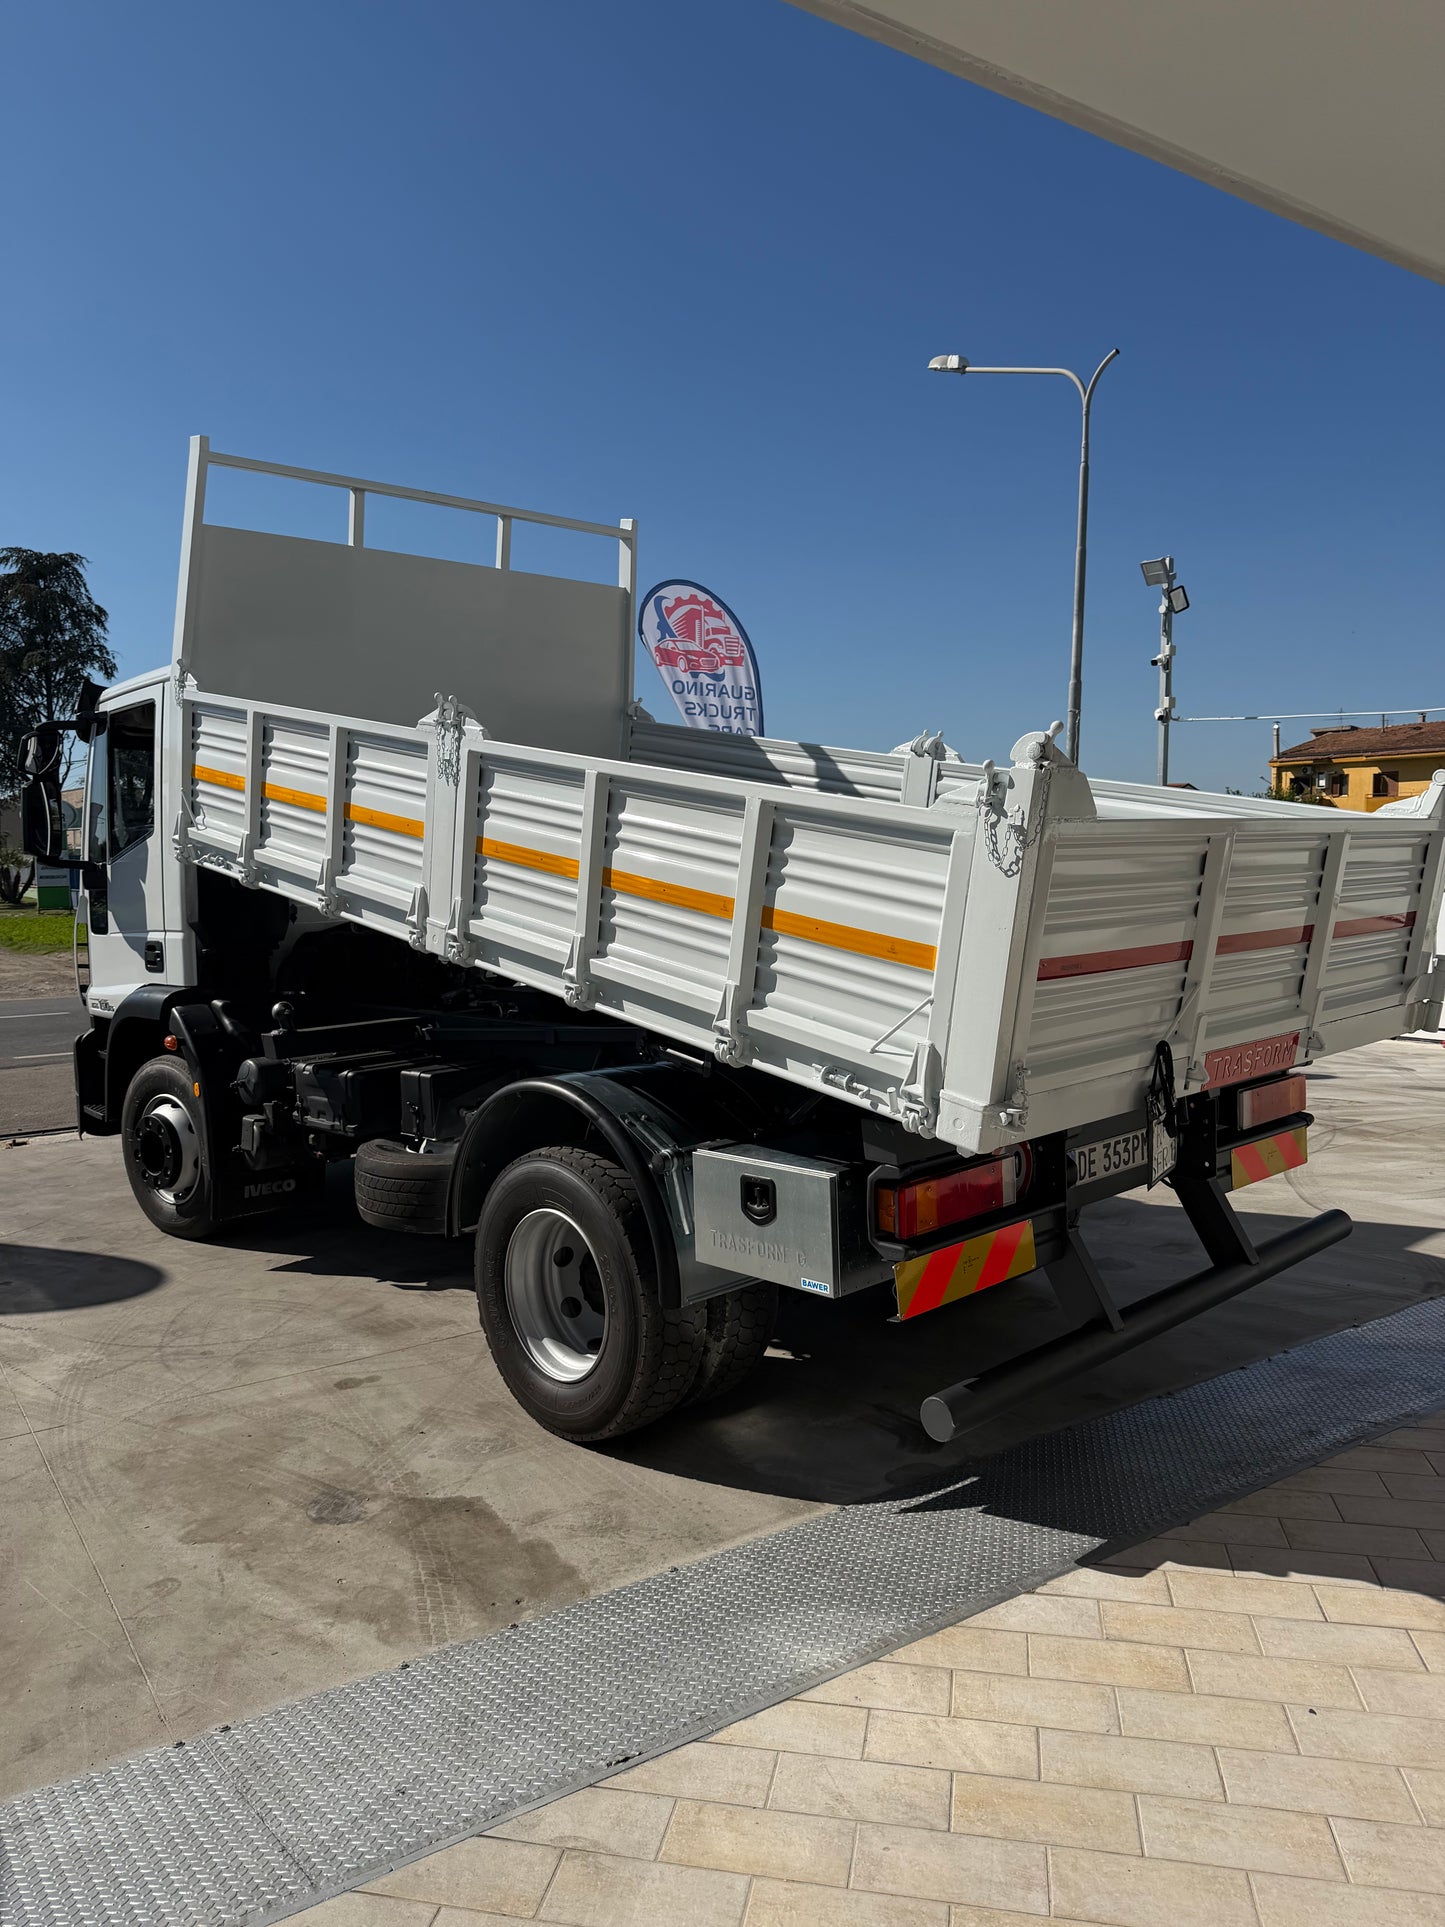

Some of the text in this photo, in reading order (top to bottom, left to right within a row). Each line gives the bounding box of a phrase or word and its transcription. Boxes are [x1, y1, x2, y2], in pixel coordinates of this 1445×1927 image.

[1213, 1042, 1294, 1081] TRASFORM
[1078, 1147, 1097, 1182] DE
[244, 1179, 296, 1199] IVECO
[802, 1279, 829, 1293] BAWER
